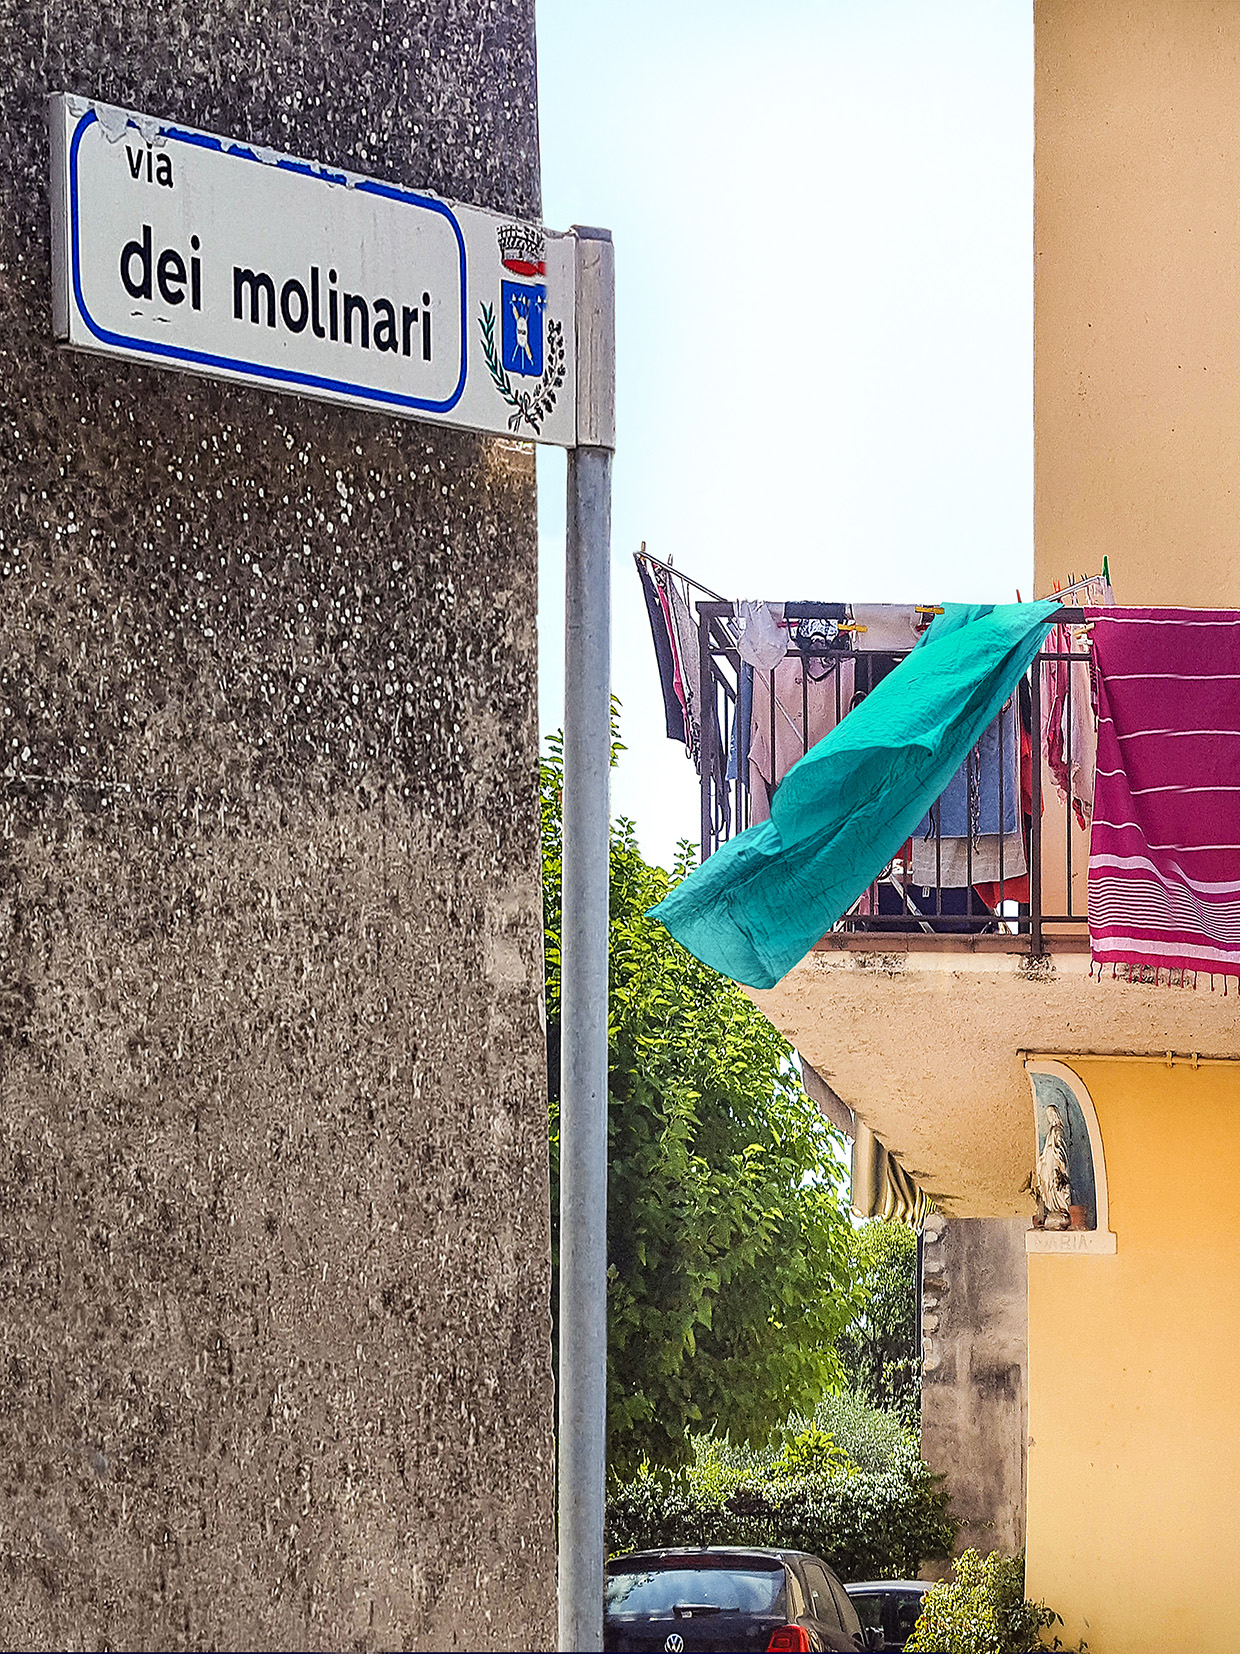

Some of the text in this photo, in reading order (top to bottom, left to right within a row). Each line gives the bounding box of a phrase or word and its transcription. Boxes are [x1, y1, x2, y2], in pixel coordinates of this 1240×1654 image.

[125, 144, 174, 188] via
[120, 224, 432, 361] dei molinari
